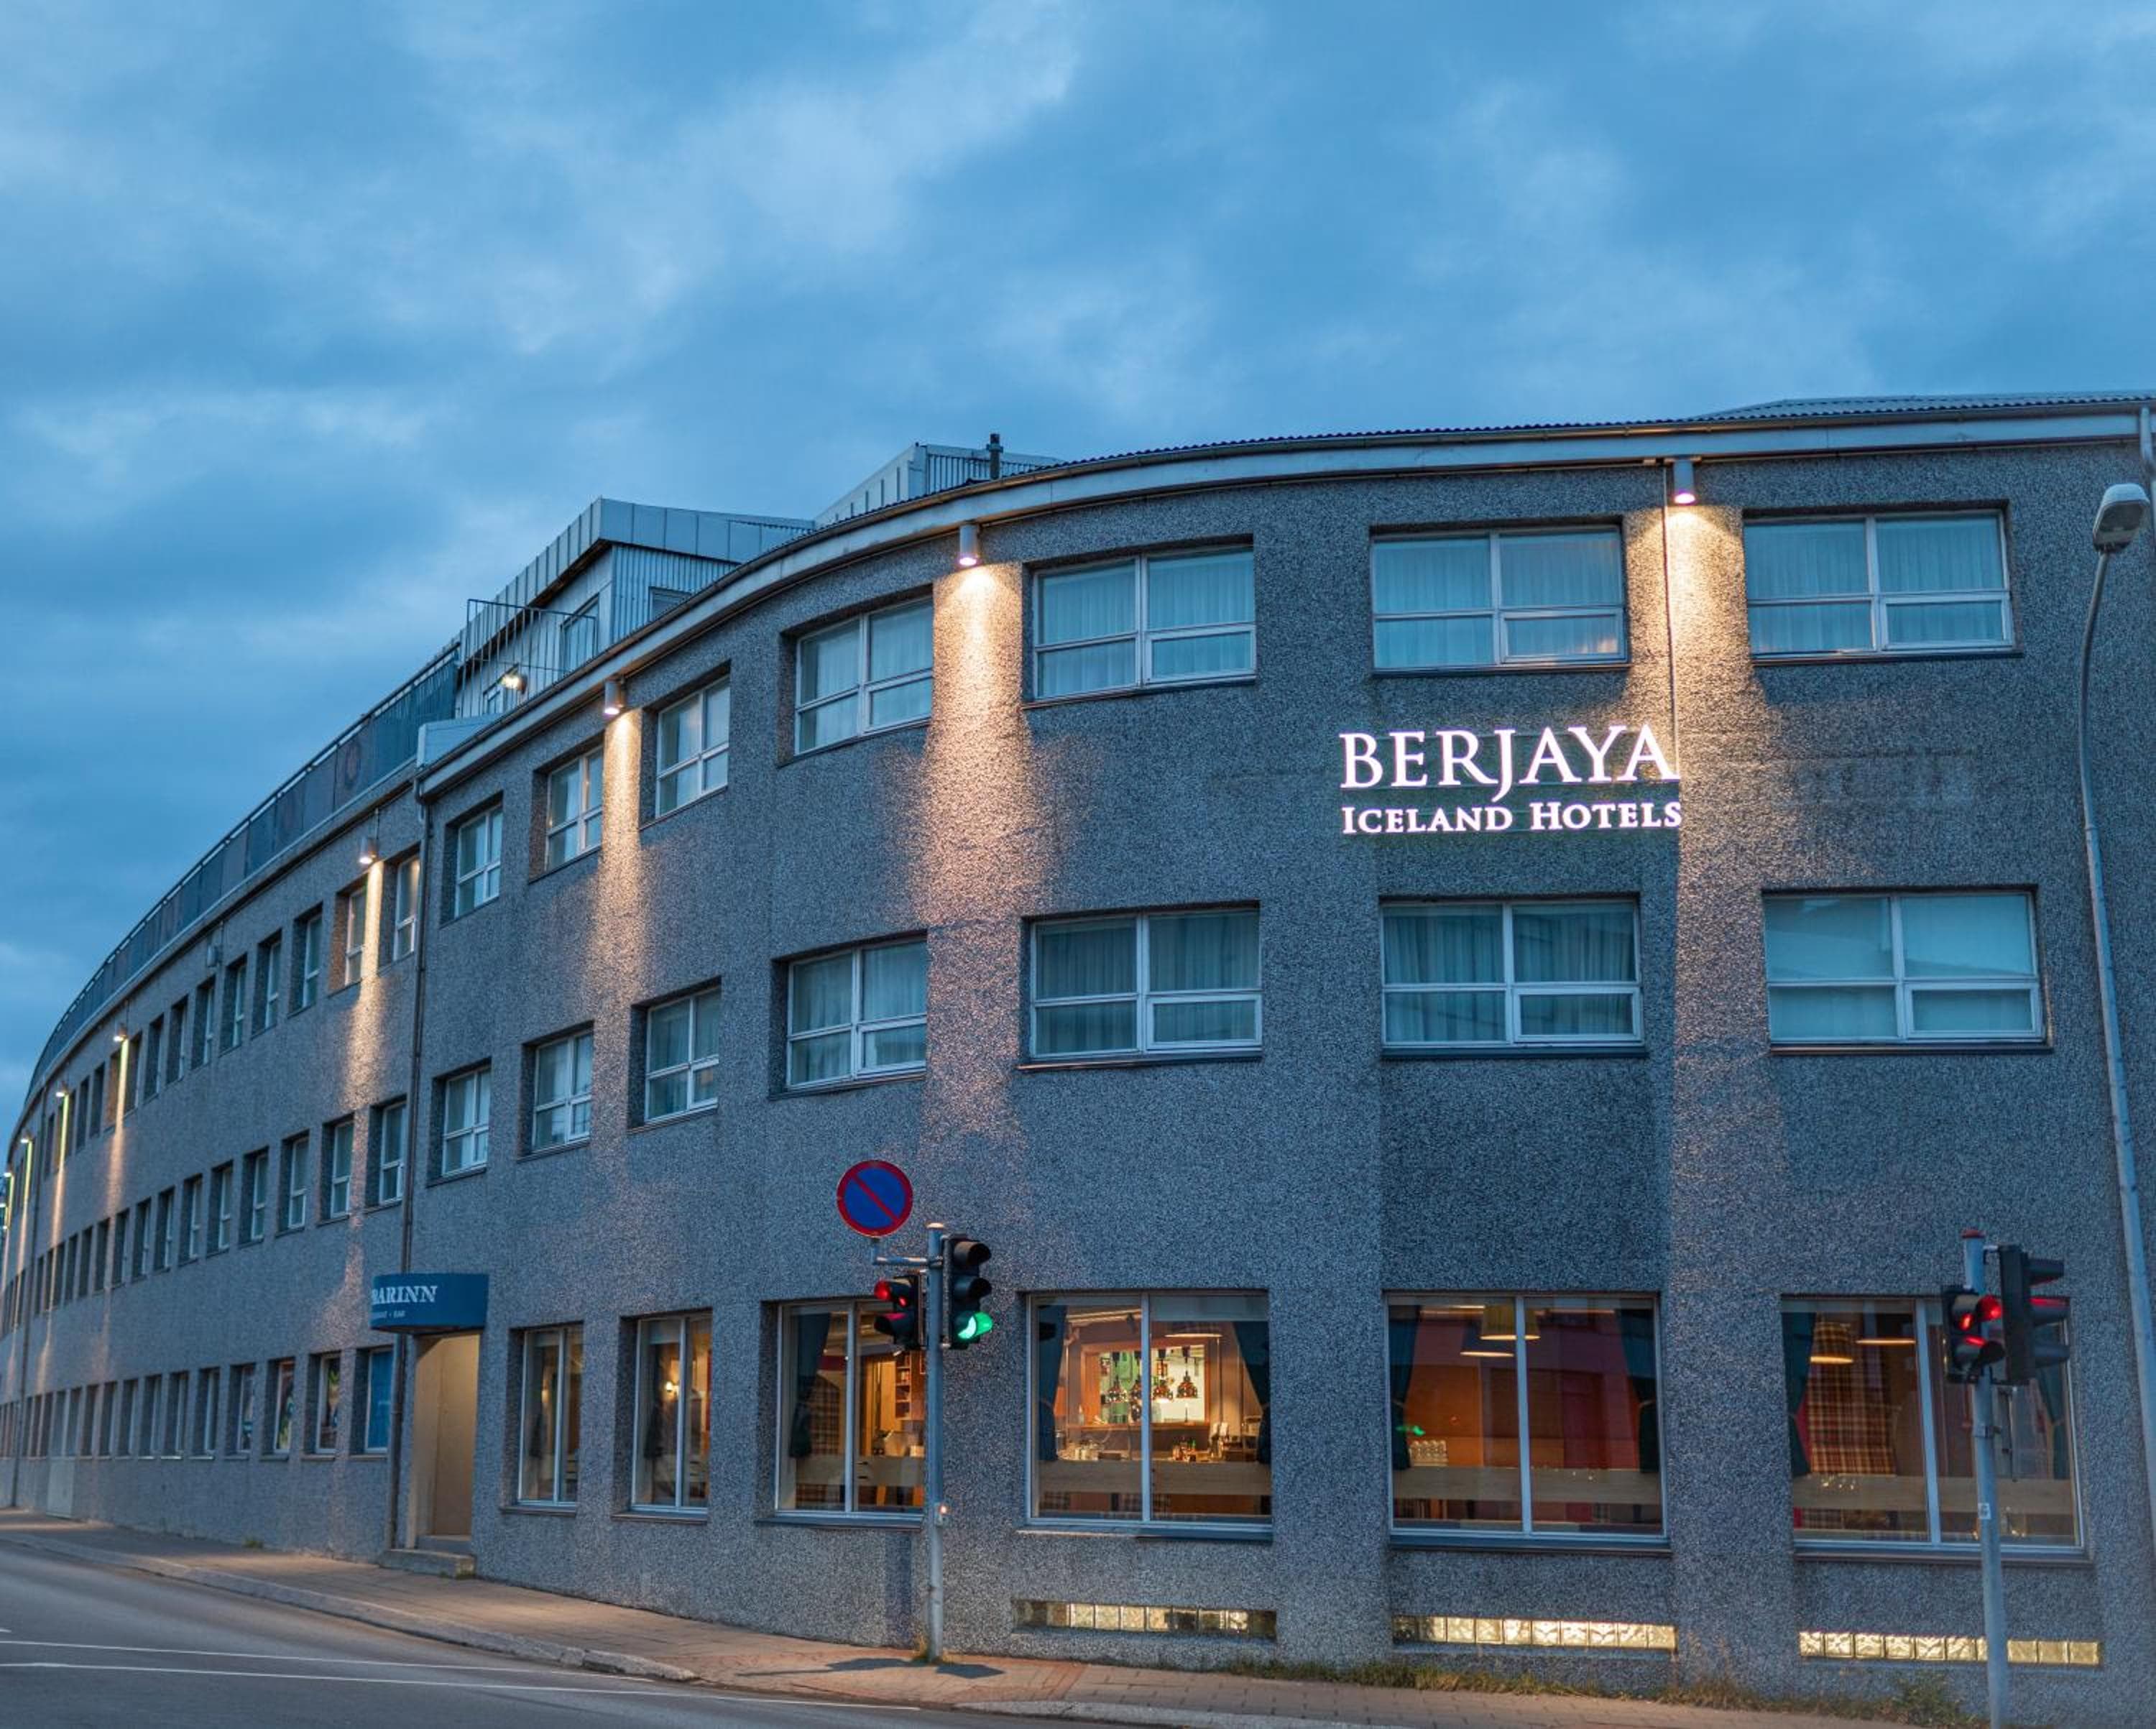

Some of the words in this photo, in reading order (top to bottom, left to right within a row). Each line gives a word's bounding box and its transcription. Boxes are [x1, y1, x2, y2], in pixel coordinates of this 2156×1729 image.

[1339, 723, 1680, 803] BERJAYA
[1342, 806, 1513, 834] ICELAND
[1529, 801, 1682, 831] HOTELS
